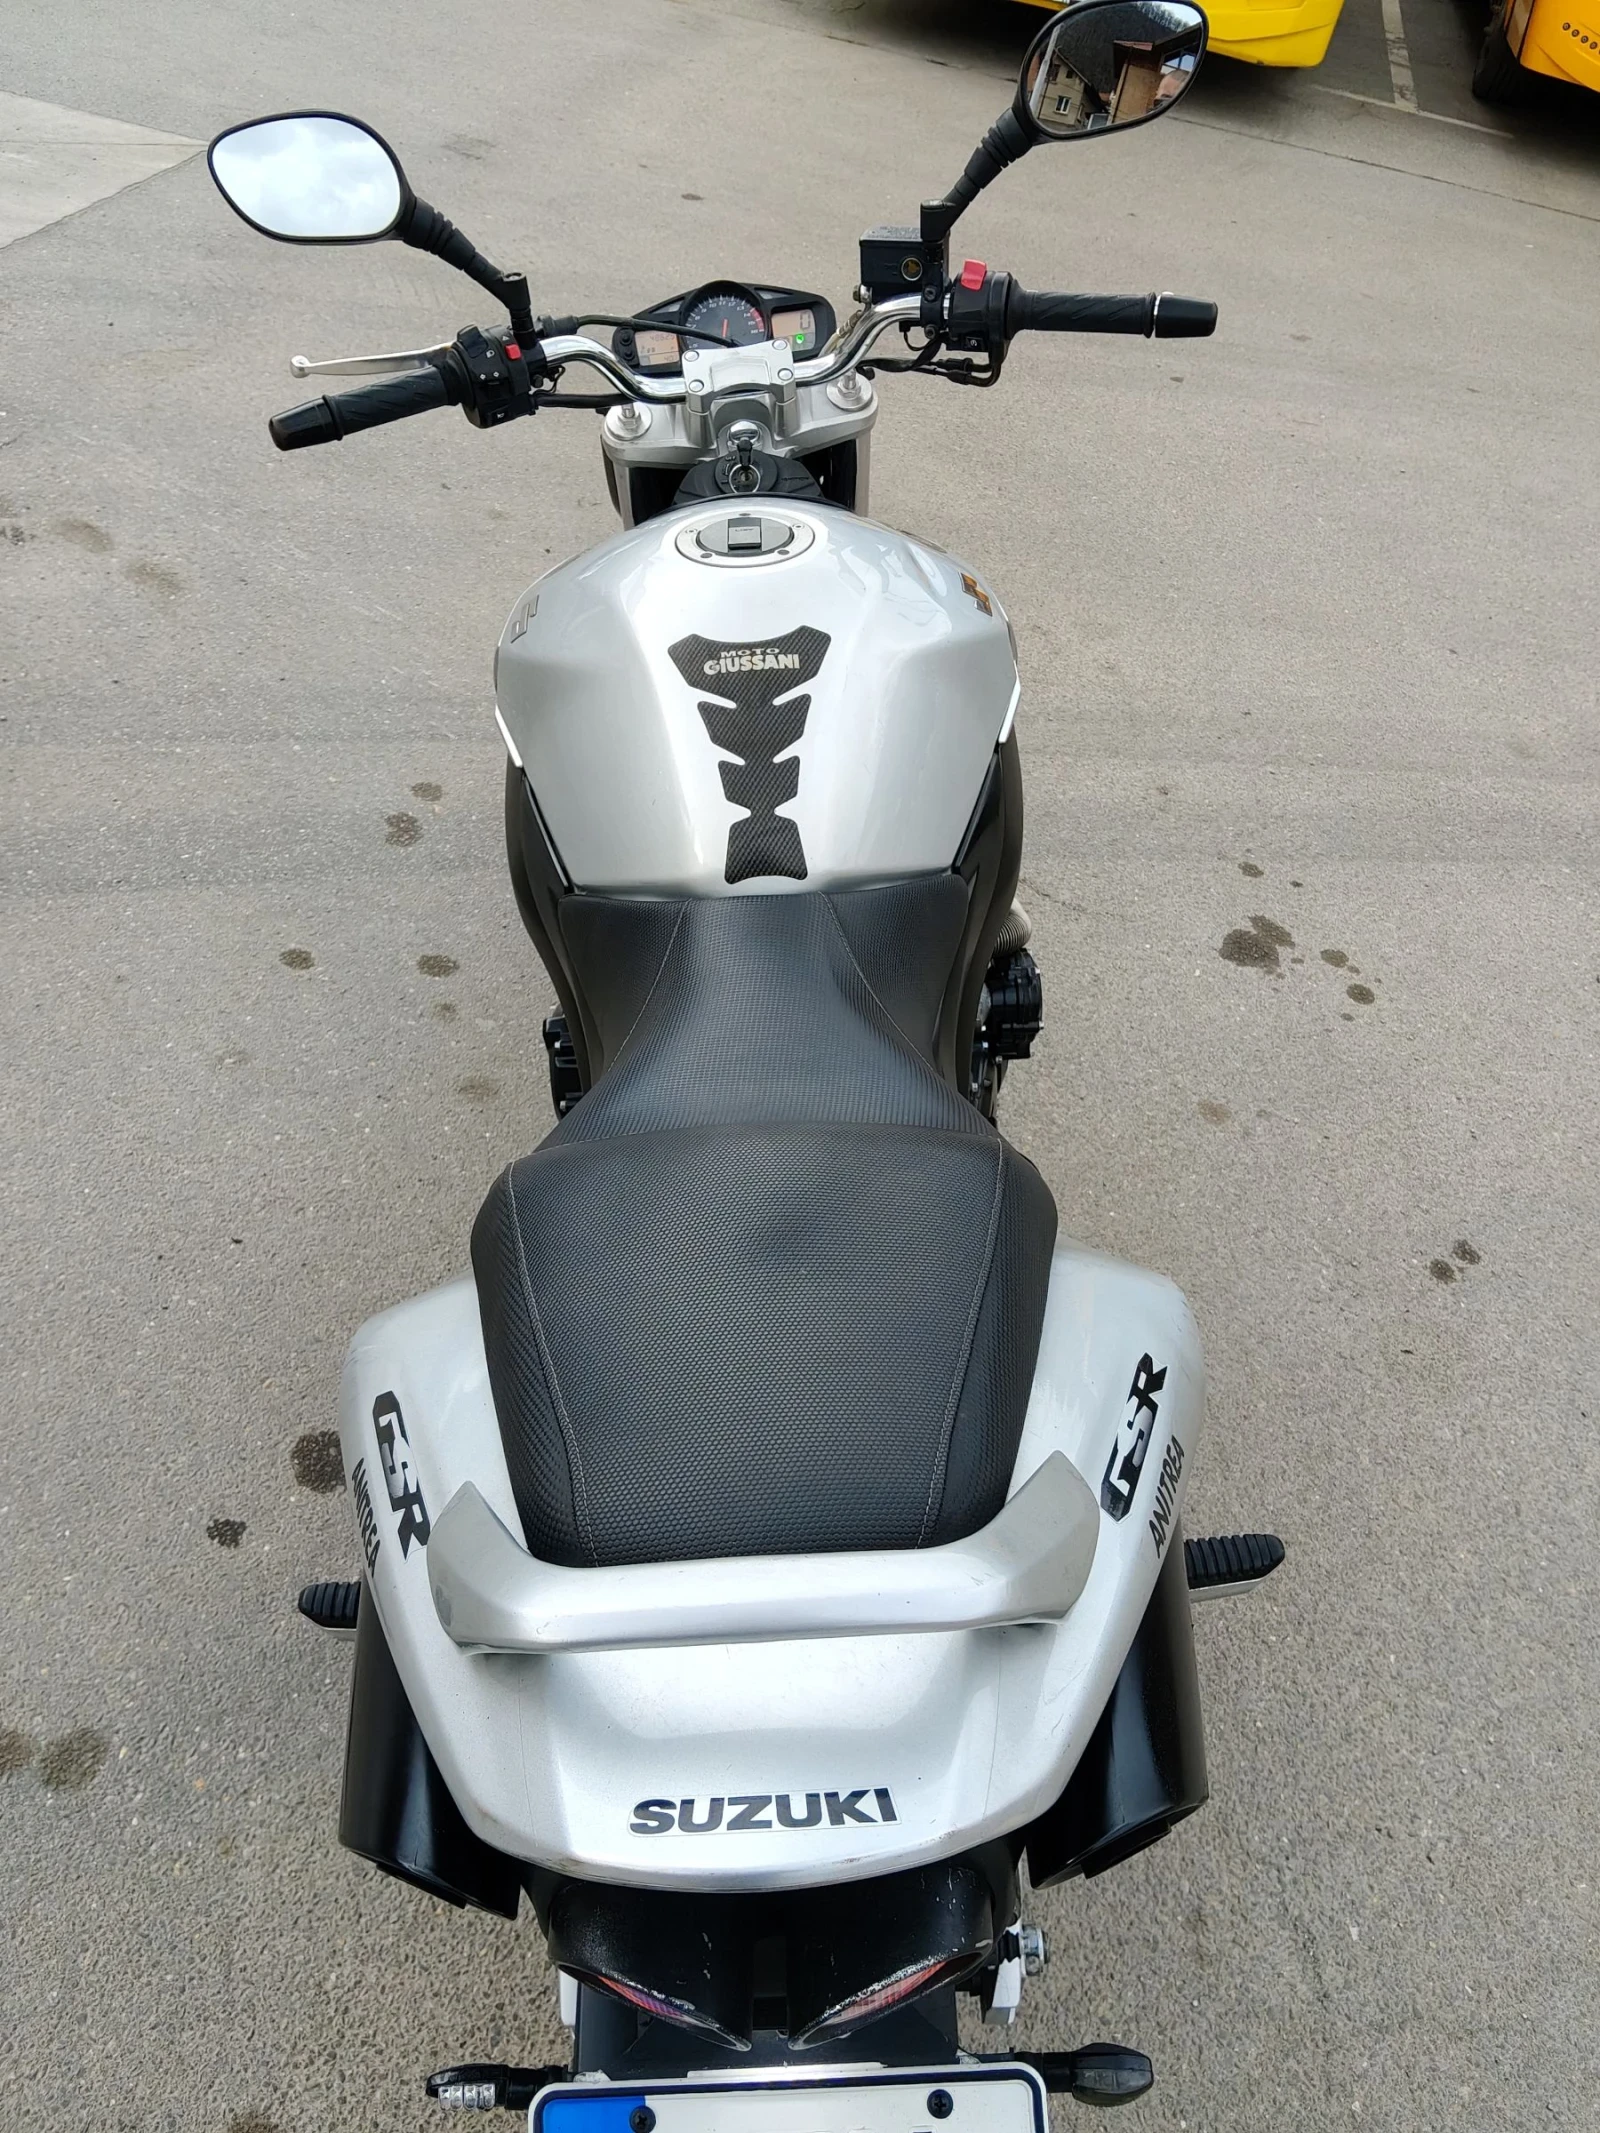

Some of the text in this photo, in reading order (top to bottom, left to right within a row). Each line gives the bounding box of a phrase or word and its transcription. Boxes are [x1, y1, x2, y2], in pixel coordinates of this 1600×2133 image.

[800, 311, 811, 330] 0
[703, 654, 801, 676] GIUSSANI
[720, 647, 780, 657] MOTO
[1148, 1434, 1185, 1560] ANITREA
[351, 1457, 381, 1579] ANITREA
[629, 1787, 898, 1835] SUZUKI
